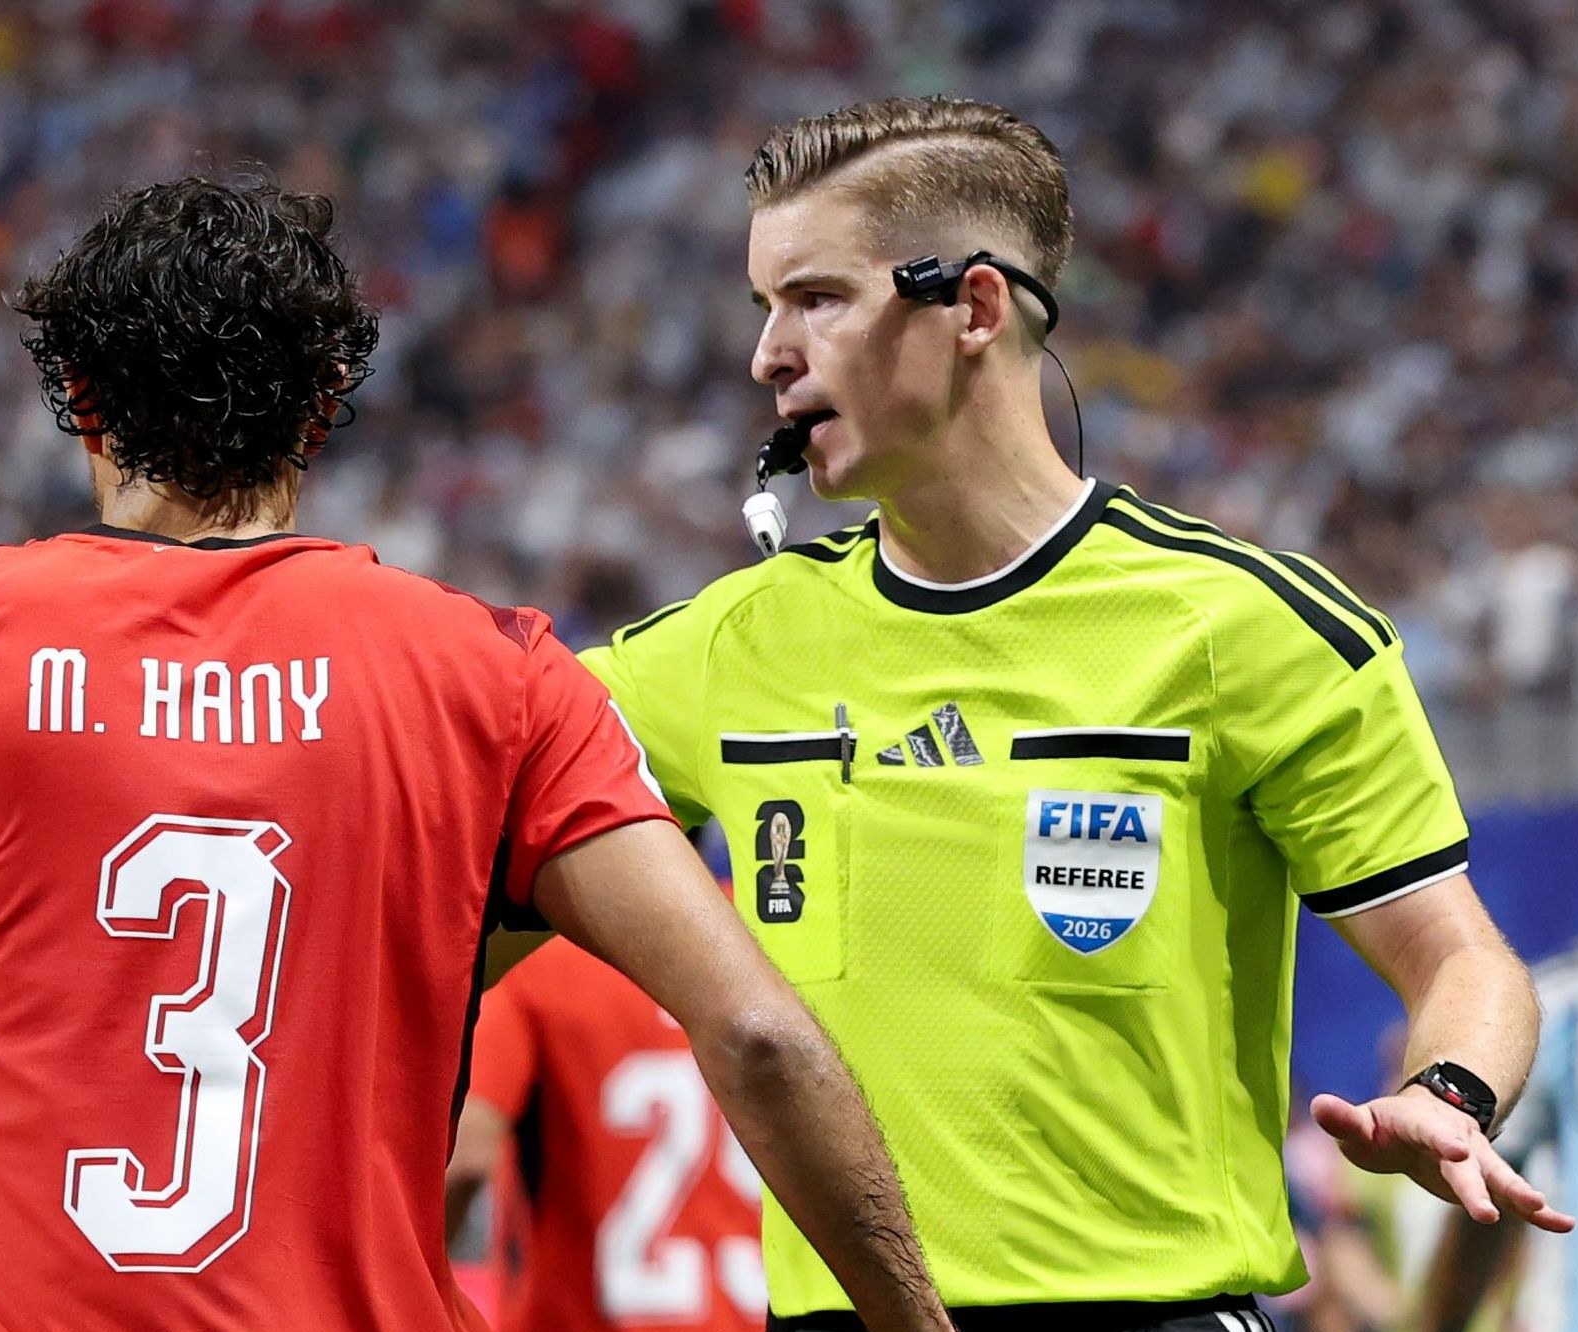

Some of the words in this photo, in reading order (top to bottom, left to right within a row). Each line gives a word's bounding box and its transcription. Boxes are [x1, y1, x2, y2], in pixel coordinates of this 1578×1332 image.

[914, 267, 940, 281] Lenovo
[28, 647, 105, 732] M.
[139, 656, 329, 744] HANY
[1038, 801, 1148, 842] FIFA
[1035, 865, 1145, 890] REFEREE
[768, 898, 792, 914] FIFA
[1062, 919, 1112, 940] 2026
[63, 813, 293, 1273] 3
